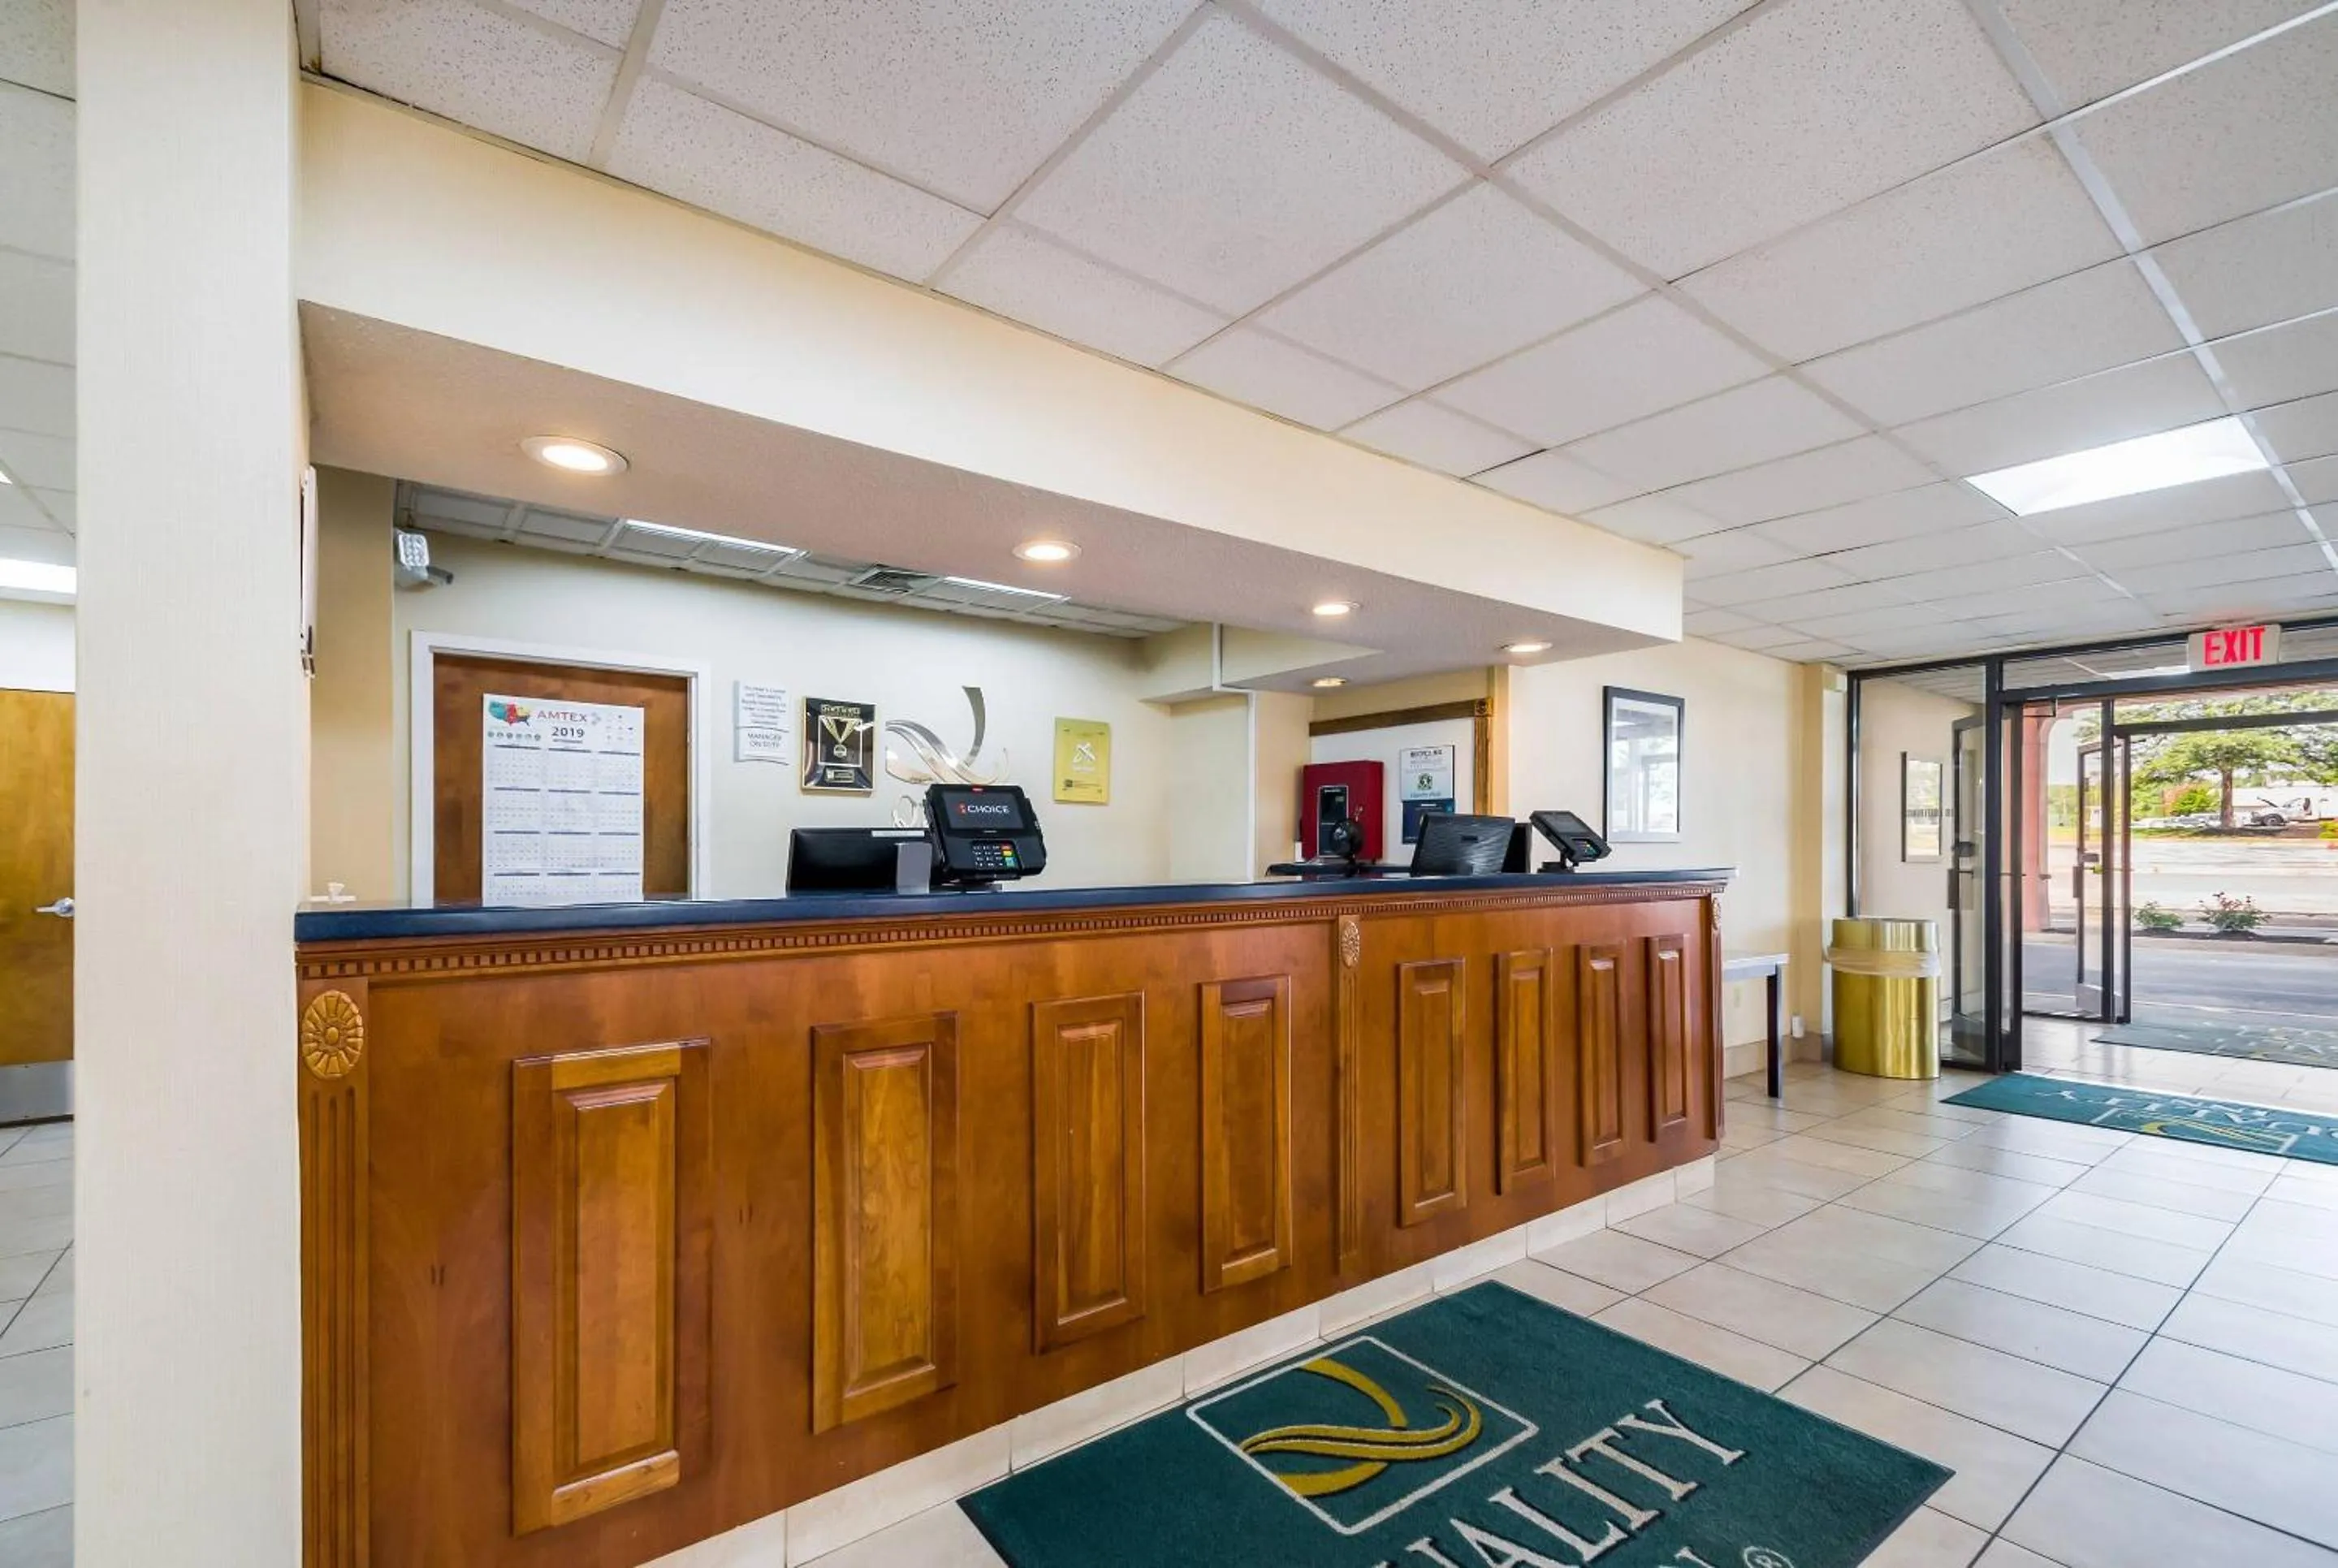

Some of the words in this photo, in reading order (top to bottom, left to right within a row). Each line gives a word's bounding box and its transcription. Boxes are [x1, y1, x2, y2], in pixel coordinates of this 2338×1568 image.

[2203, 625, 2265, 665] EXIT
[538, 711, 586, 722] AMTEX
[552, 726, 585, 738] 2019
[967, 805, 1009, 813] CHOICE
